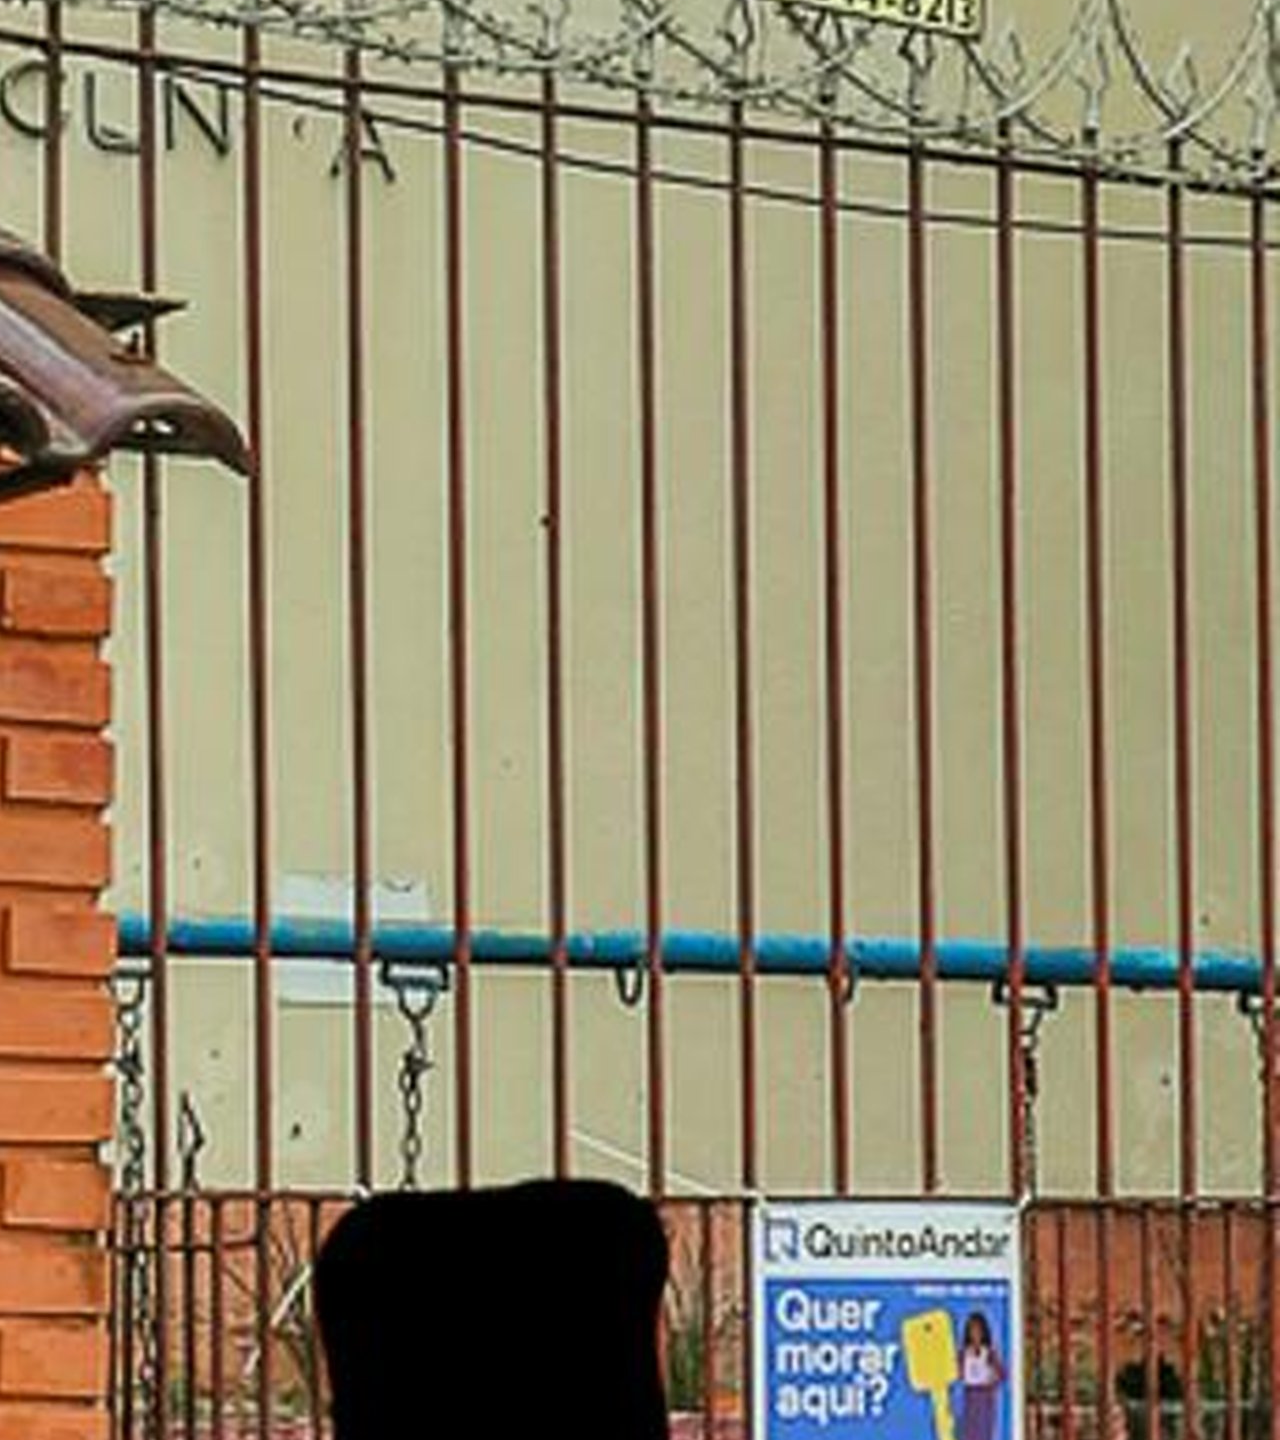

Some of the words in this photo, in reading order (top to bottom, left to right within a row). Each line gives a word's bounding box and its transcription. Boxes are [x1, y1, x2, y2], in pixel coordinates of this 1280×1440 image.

[804, 1221, 1011, 1259] QuintoAndar
[775, 1289, 882, 1333] Quer
[775, 1341, 899, 1375] morar
[774, 1373, 889, 1426] aqui?
